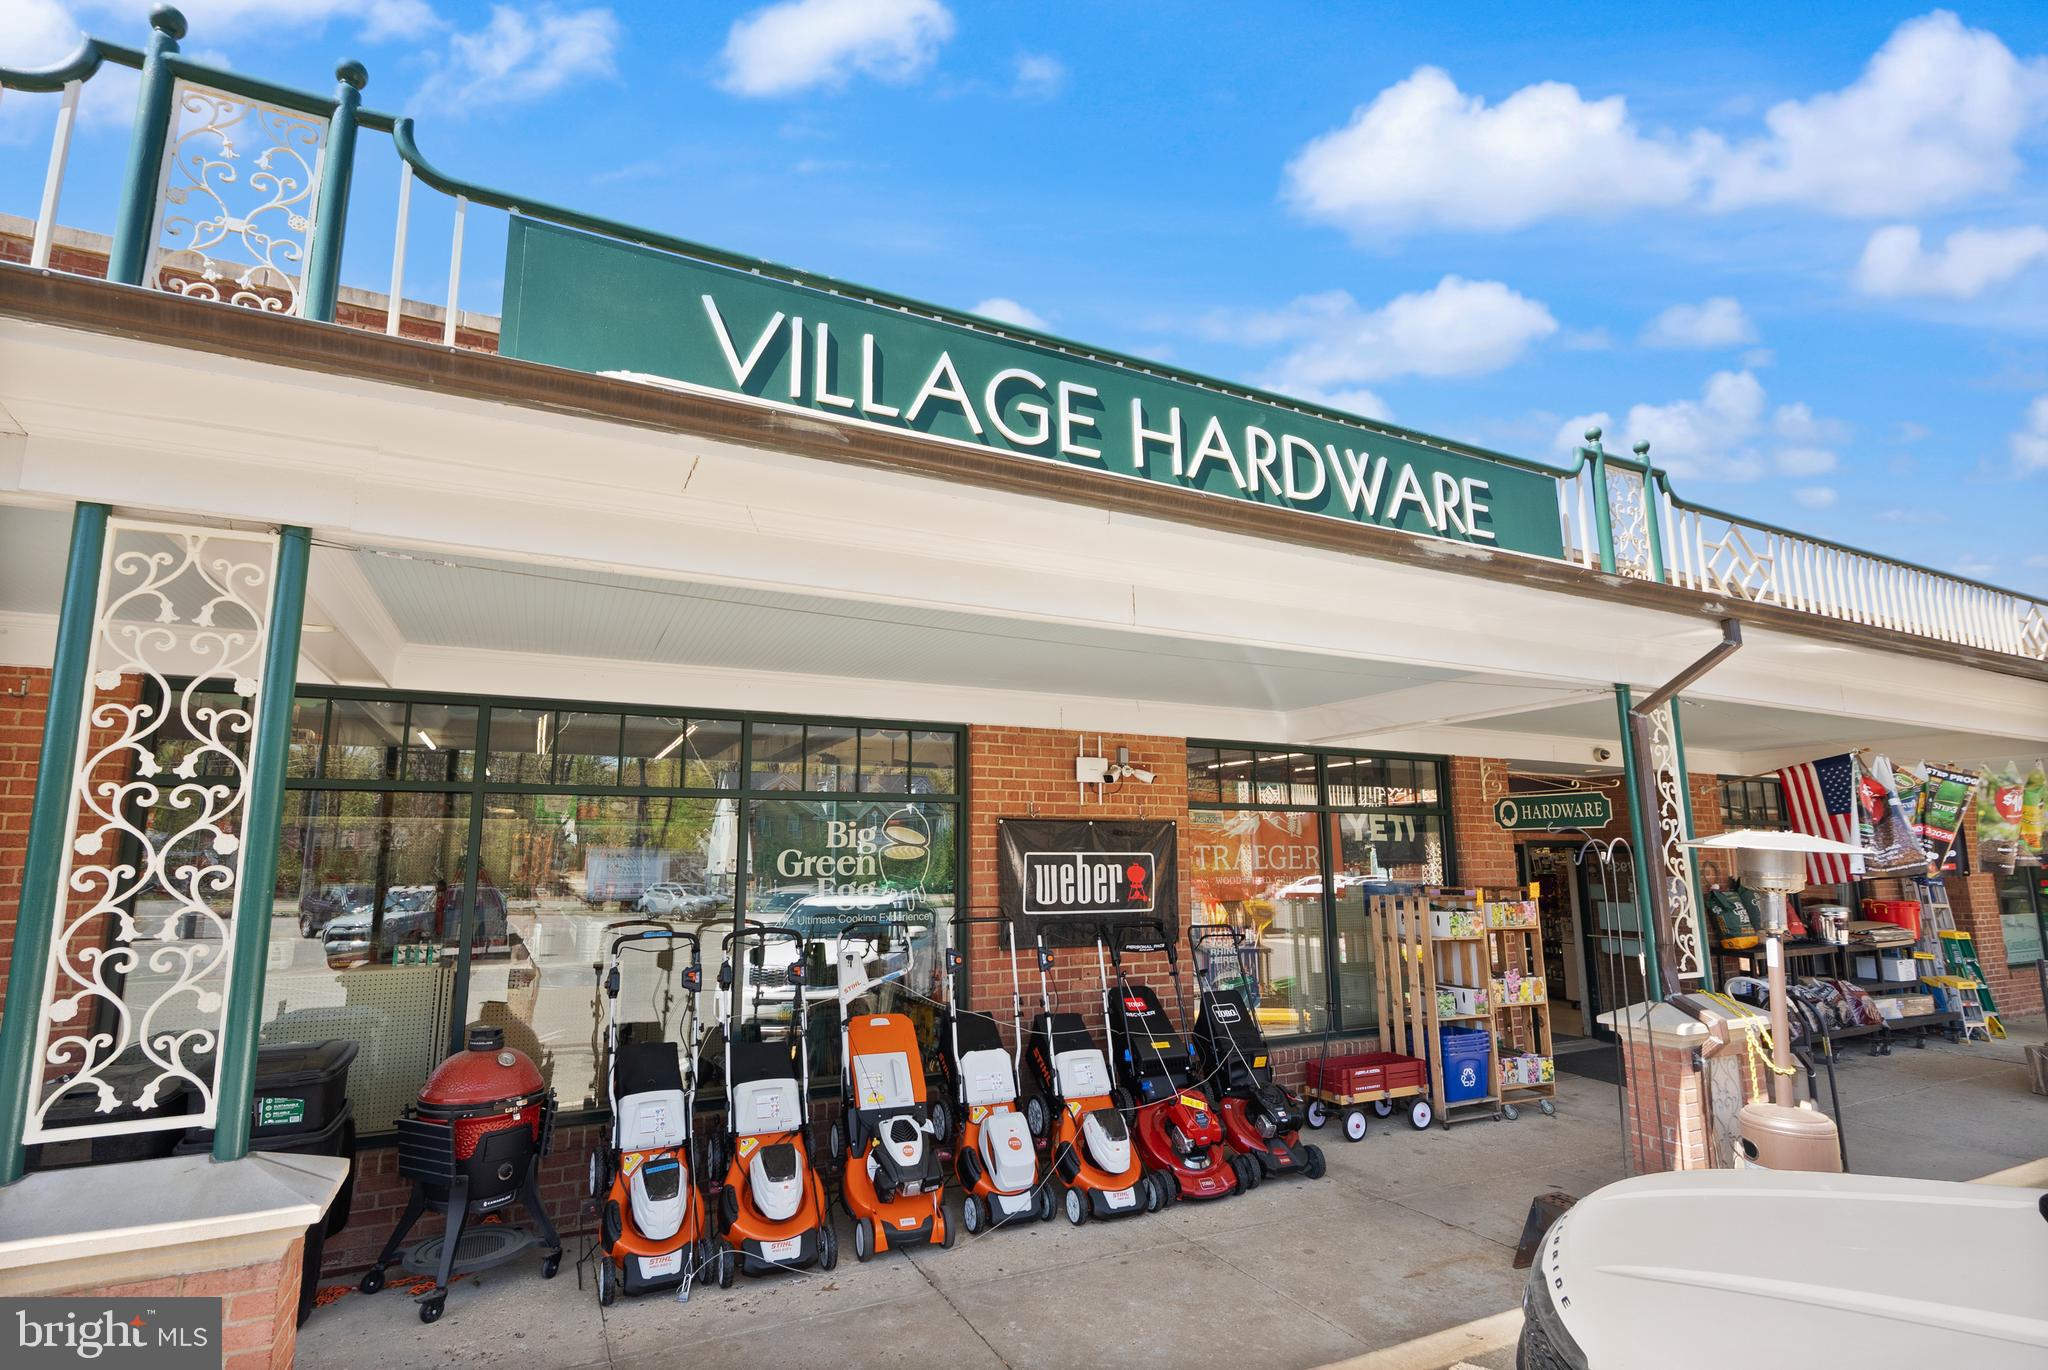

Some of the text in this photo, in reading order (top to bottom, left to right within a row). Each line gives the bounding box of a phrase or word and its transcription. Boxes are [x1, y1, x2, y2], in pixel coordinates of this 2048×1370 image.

[702, 294, 1495, 539] VILLAGE HARDWARE
[1521, 801, 1604, 820] HARDWARE
[826, 820, 877, 855] Big
[1344, 813, 1415, 842] YETI
[776, 849, 877, 877] Green
[1194, 844, 1320, 871] TRAEGER
[1034, 854, 1123, 905] weber
[797, 914, 839, 926] Ultimate
[838, 913, 877, 925] Cooking
[843, 981, 862, 994] STIHL
[1216, 1009, 1236, 1018] TORO
[771, 1240, 793, 1250] STIHL
[649, 1256, 673, 1265] STIHL
